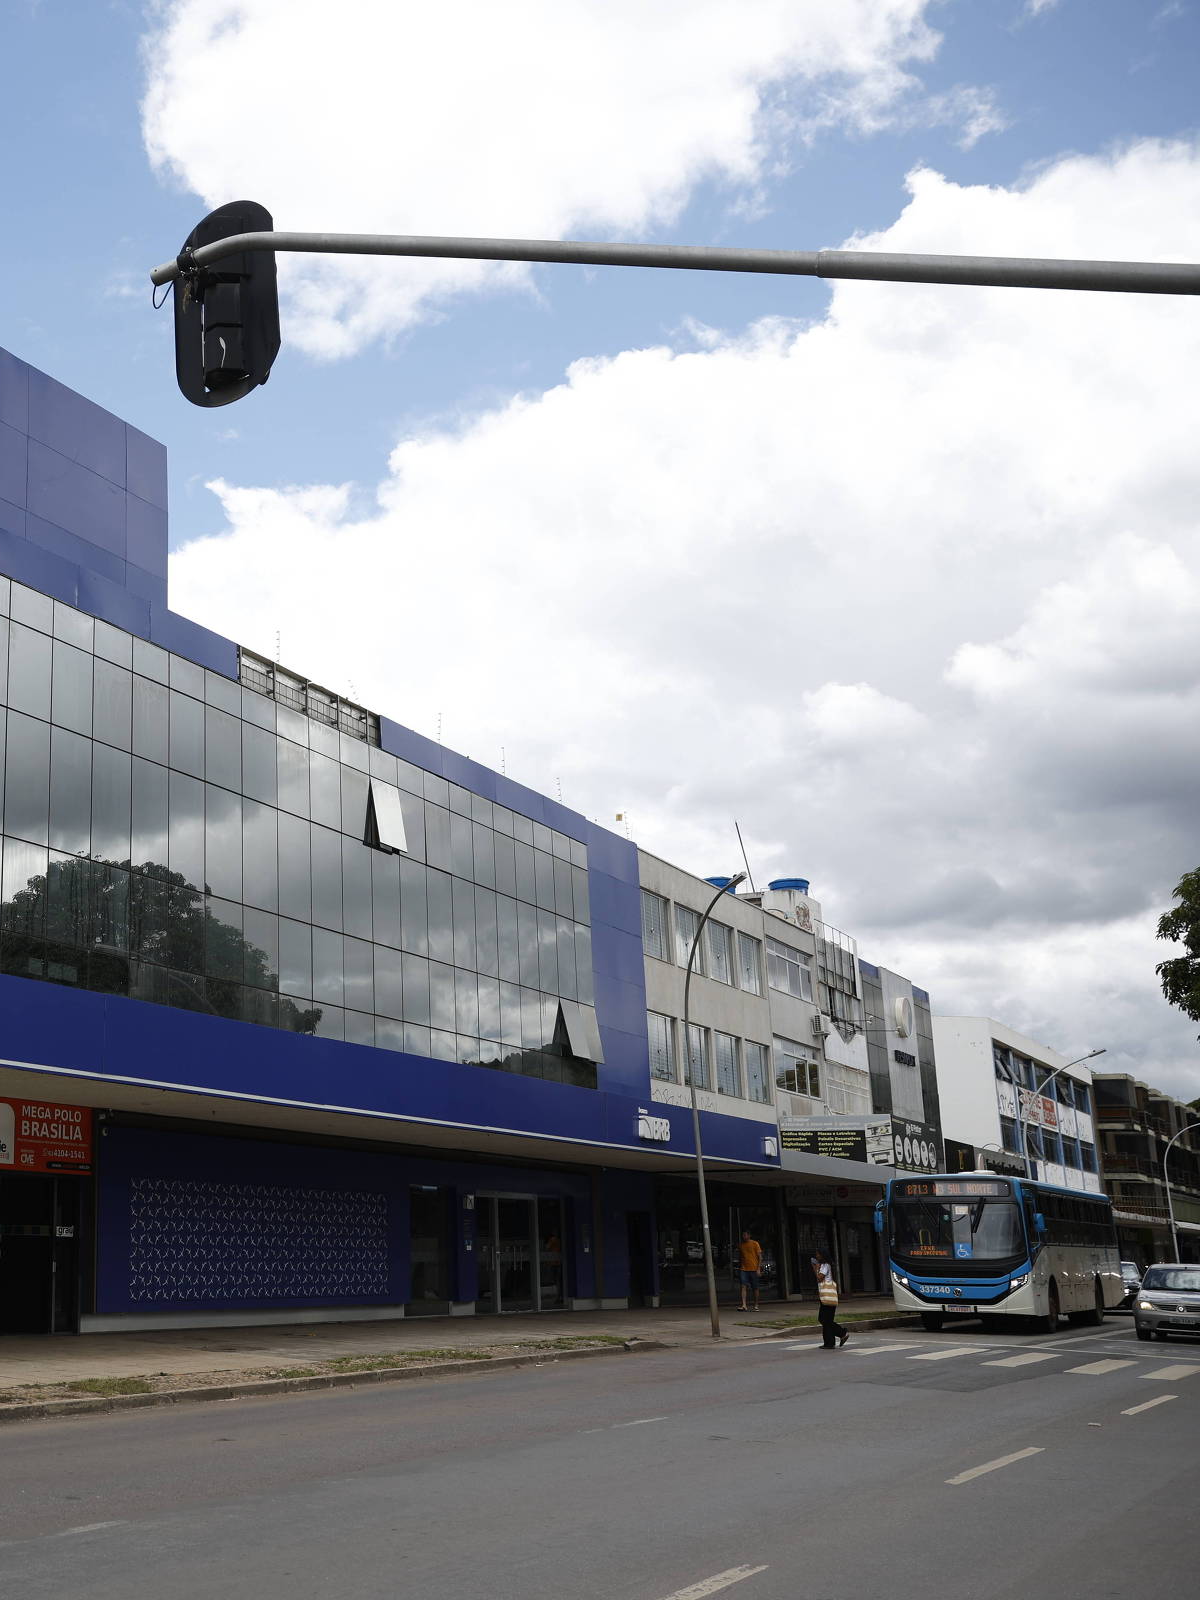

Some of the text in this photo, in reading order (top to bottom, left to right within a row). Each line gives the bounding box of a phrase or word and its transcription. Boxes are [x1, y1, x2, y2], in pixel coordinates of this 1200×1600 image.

[21, 1105, 82, 1123] MEGA POLO
[21, 1119, 83, 1141] BRASÍLIA
[948, 1183, 963, 1194] SUL
[966, 1183, 993, 1194] NORTE
[919, 1286, 951, 1294] 337340
